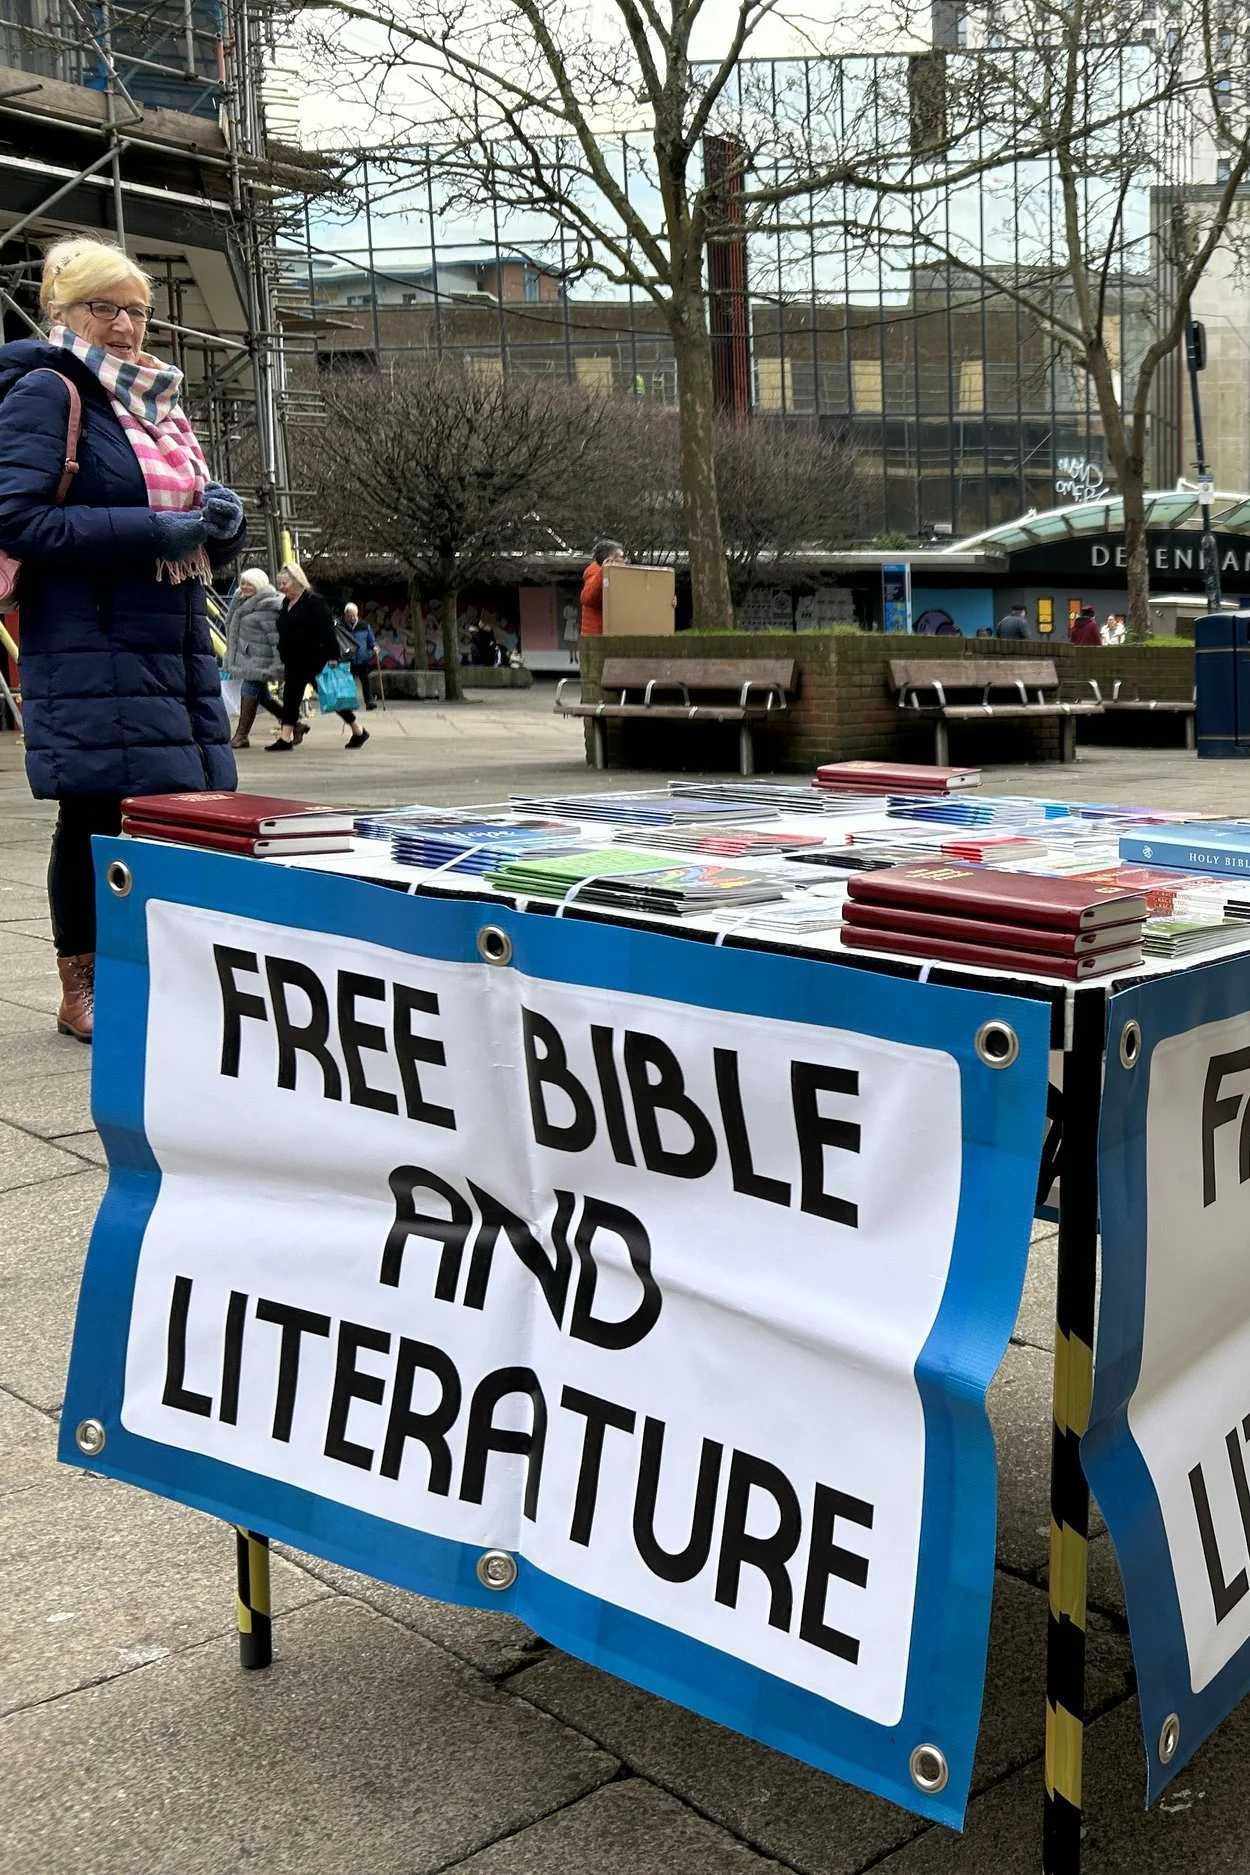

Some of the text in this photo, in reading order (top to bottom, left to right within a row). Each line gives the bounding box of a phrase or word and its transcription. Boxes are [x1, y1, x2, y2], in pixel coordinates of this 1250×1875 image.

[1189, 852, 1220, 865] HOLY
[212, 943, 860, 1230] FREE BIBLE
[379, 1164, 662, 1351] AND
[161, 1275, 875, 1666] LITERATURE
